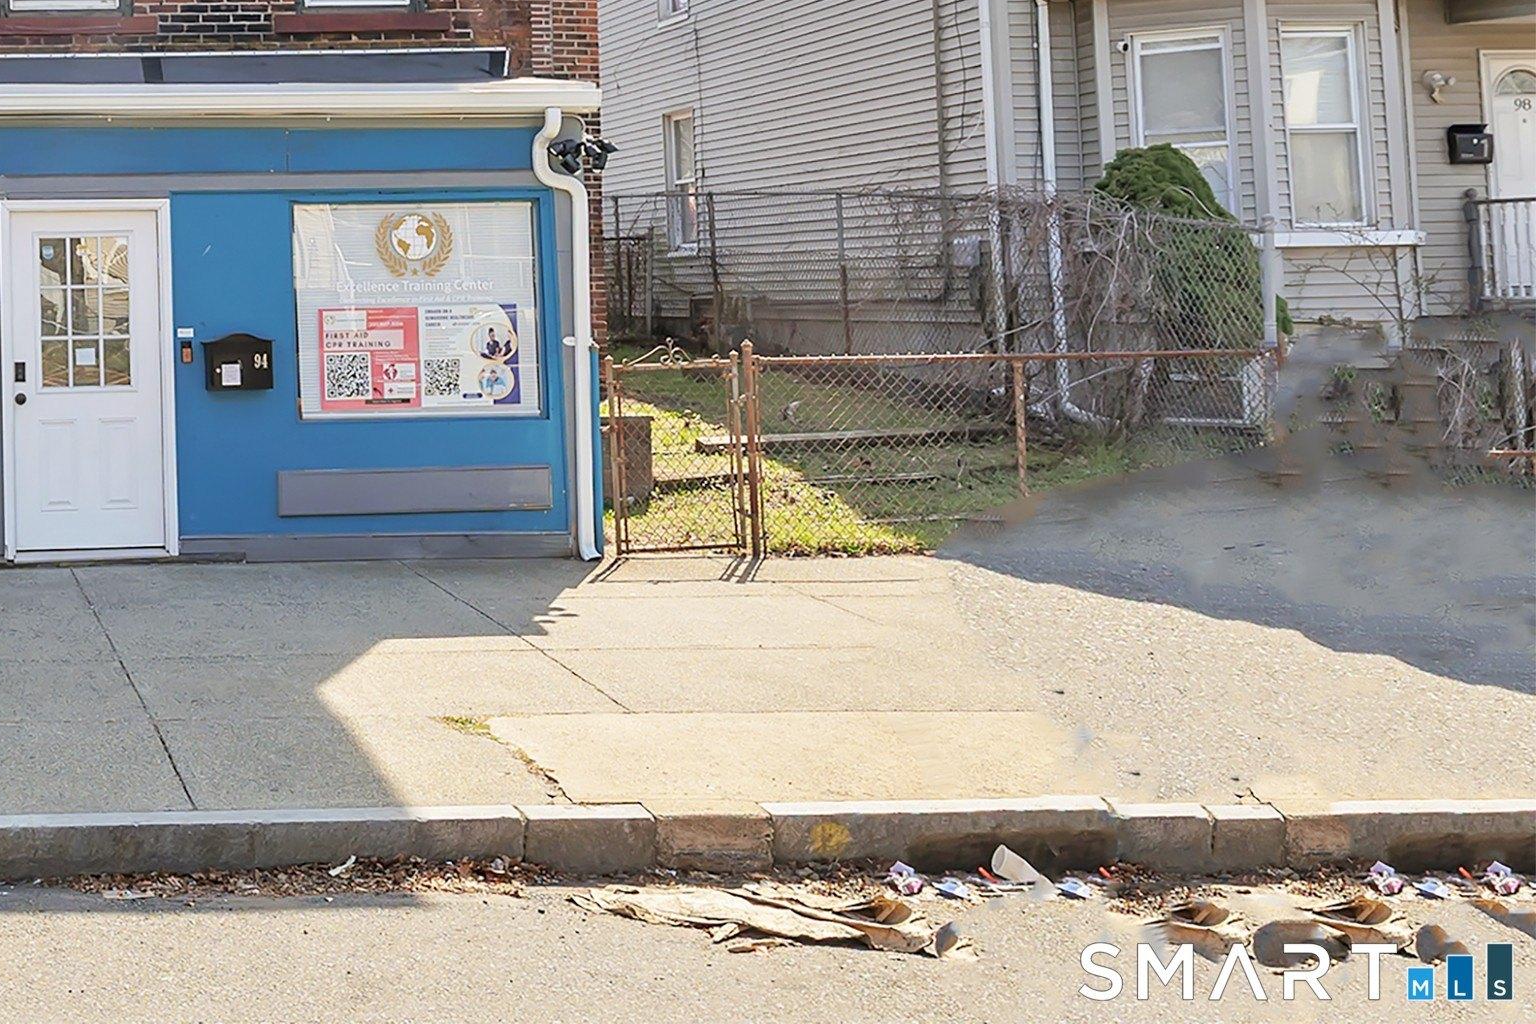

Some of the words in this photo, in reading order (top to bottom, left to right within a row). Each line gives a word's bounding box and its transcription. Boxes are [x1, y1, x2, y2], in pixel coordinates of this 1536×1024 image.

[1513, 98, 1532, 111] 98
[336, 280, 399, 293] Excellence
[403, 279, 452, 294] Training
[453, 278, 494, 291] Center
[346, 340, 391, 348] TRAINING
[253, 353, 268, 369] 94
